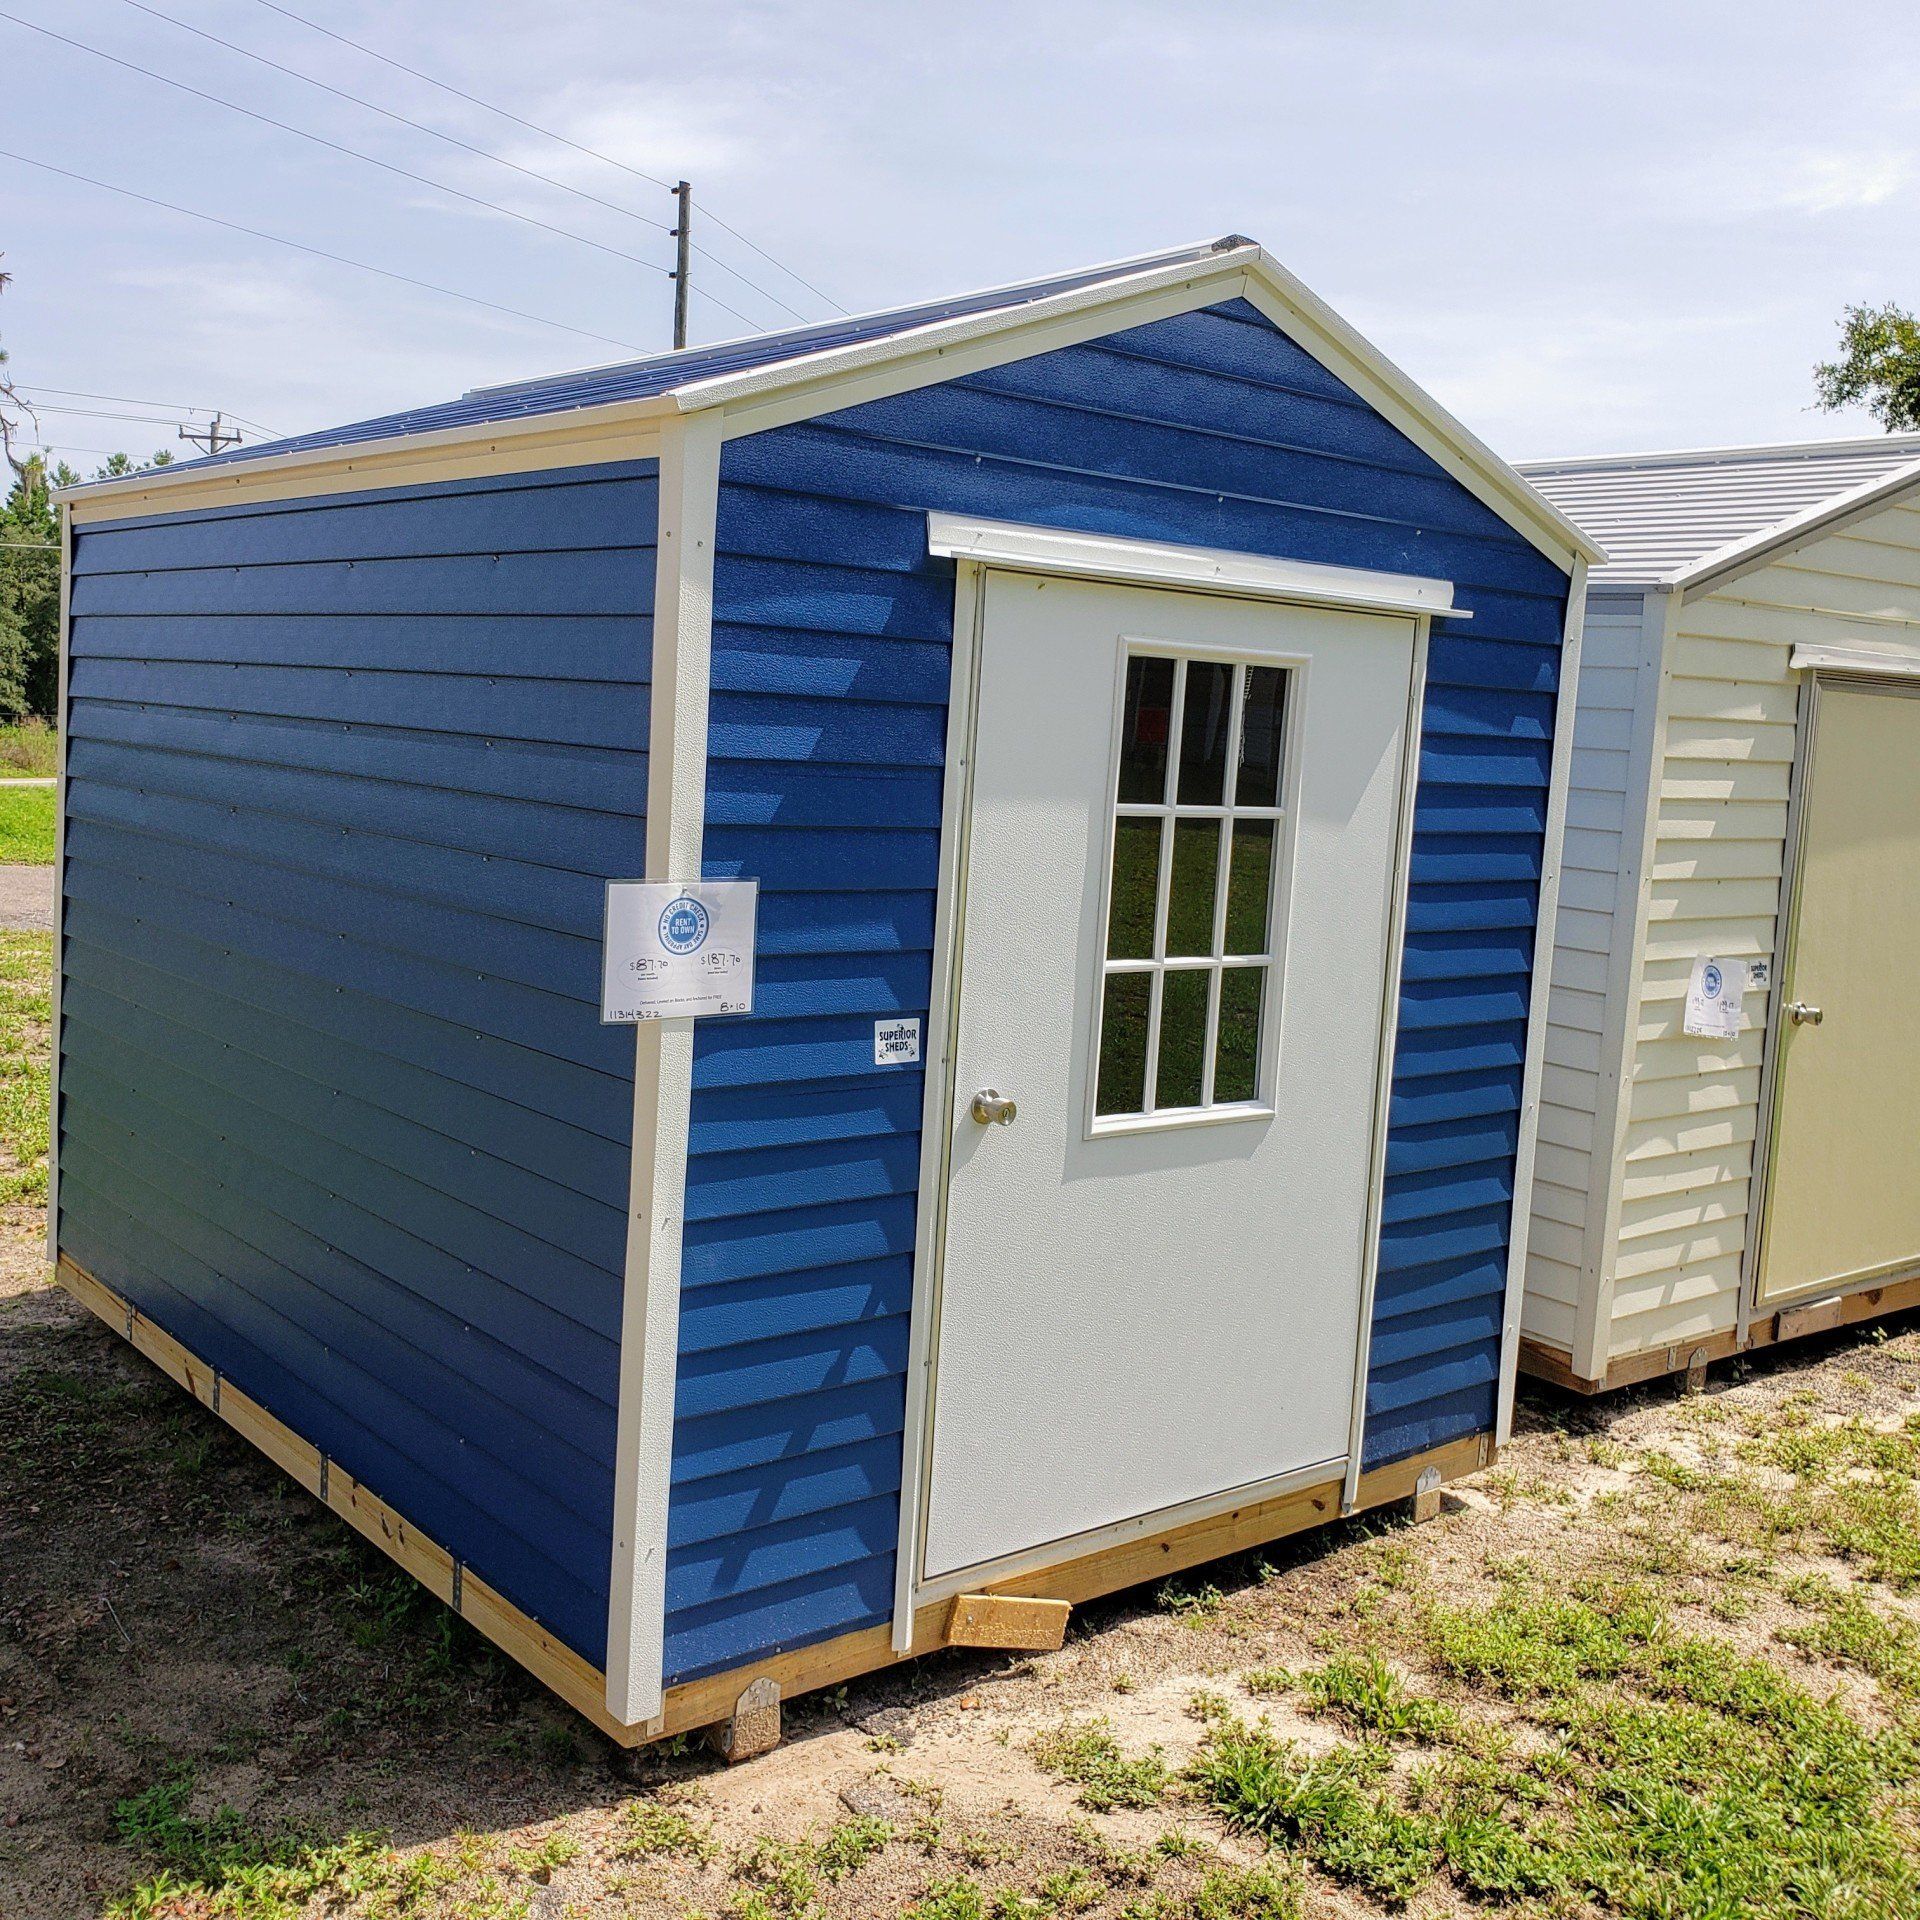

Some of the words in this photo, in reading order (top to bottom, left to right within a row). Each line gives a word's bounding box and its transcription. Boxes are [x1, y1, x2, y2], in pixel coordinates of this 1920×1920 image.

[663, 914, 671, 925] NO
[669, 902, 689, 914] CREDIT
[690, 903, 705, 923] CHECK
[675, 917, 692, 926] RENT
[671, 926, 680, 935] TO
[680, 925, 695, 934] OWN
[629, 958, 669, 971] $87.70
[700, 953, 741, 966] $187.70
[879, 1029, 917, 1041] SUPERIOR
[885, 1041, 909, 1053] SHEDS
